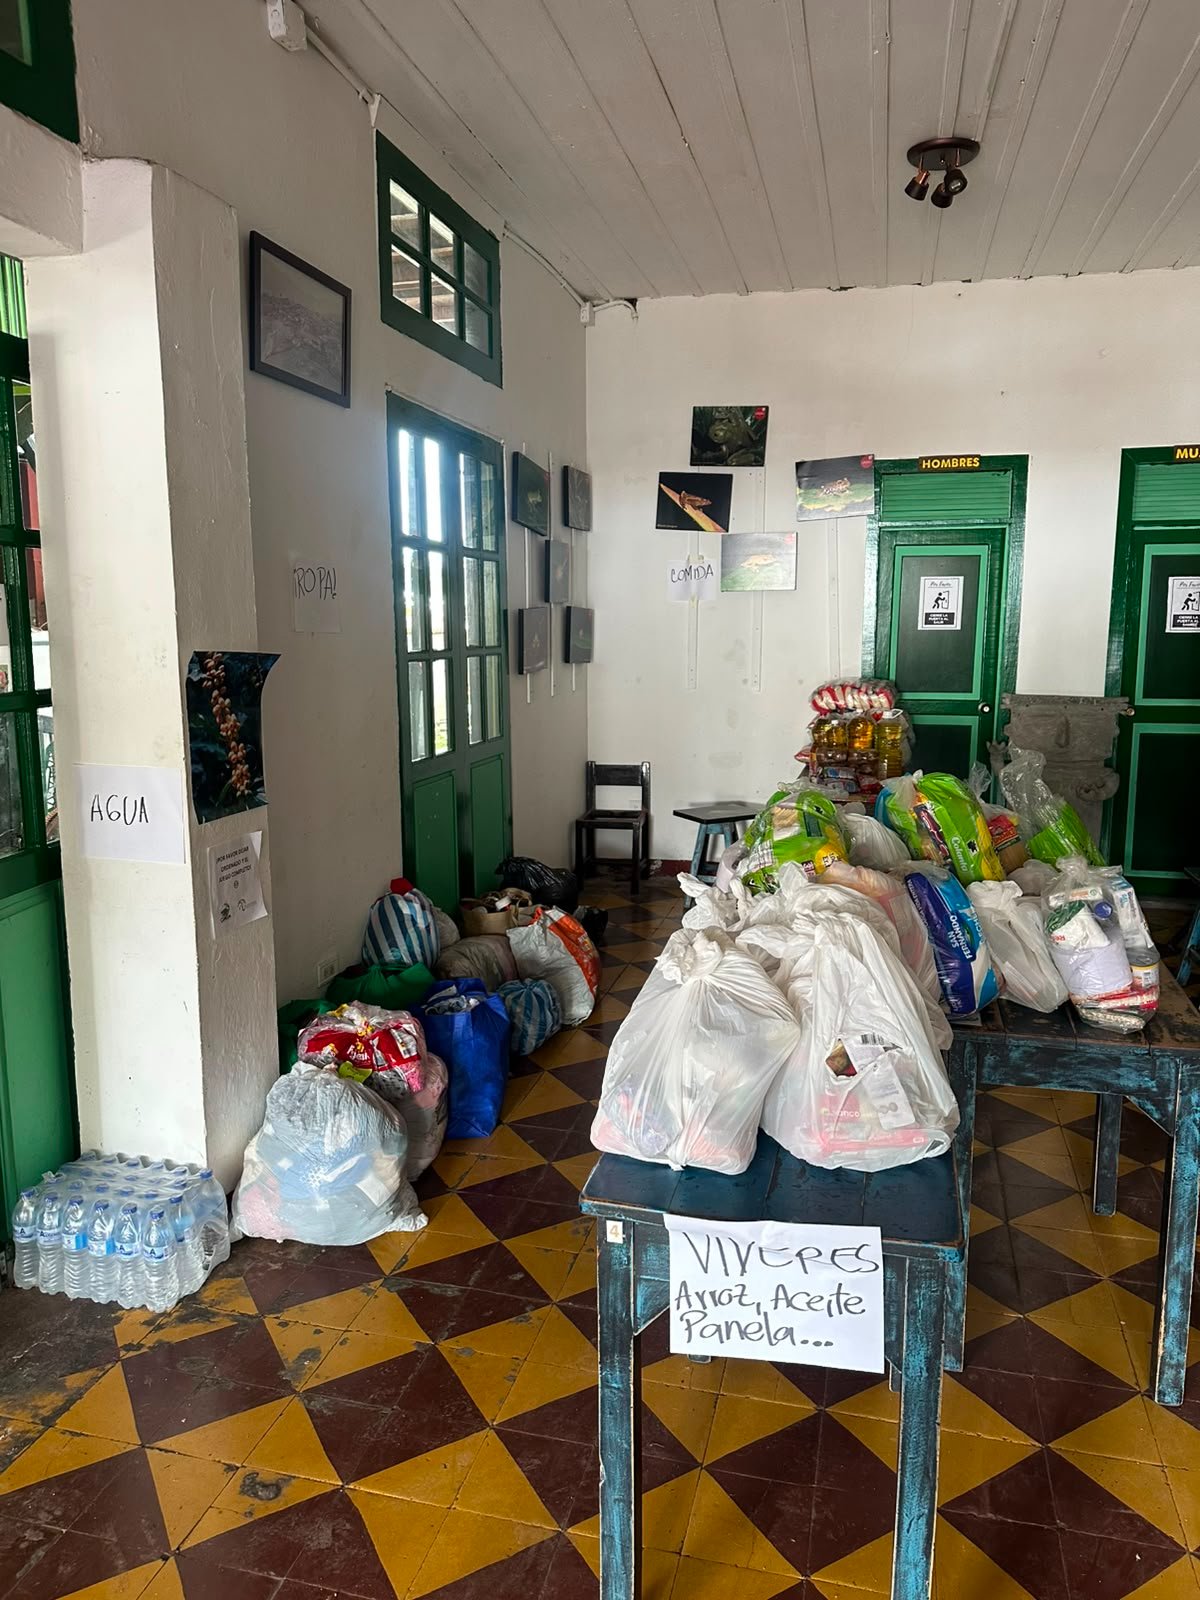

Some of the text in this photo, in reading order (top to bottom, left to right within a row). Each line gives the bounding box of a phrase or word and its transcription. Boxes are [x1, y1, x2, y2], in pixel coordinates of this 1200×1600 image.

[922, 457, 980, 469] HOMBRES
[1176, 447, 1200, 459] MU
[670, 564, 714, 583] COMIDA
[90, 794, 149, 826] AGUA
[947, 931, 960, 949] SAN
[949, 914, 973, 960] FERNANDO
[609, 1224, 620, 1238] 4
[682, 1231, 880, 1277] VIVERES
[674, 1280, 866, 1318] Arroz, Aceite
[680, 1310, 834, 1347] Panela...
